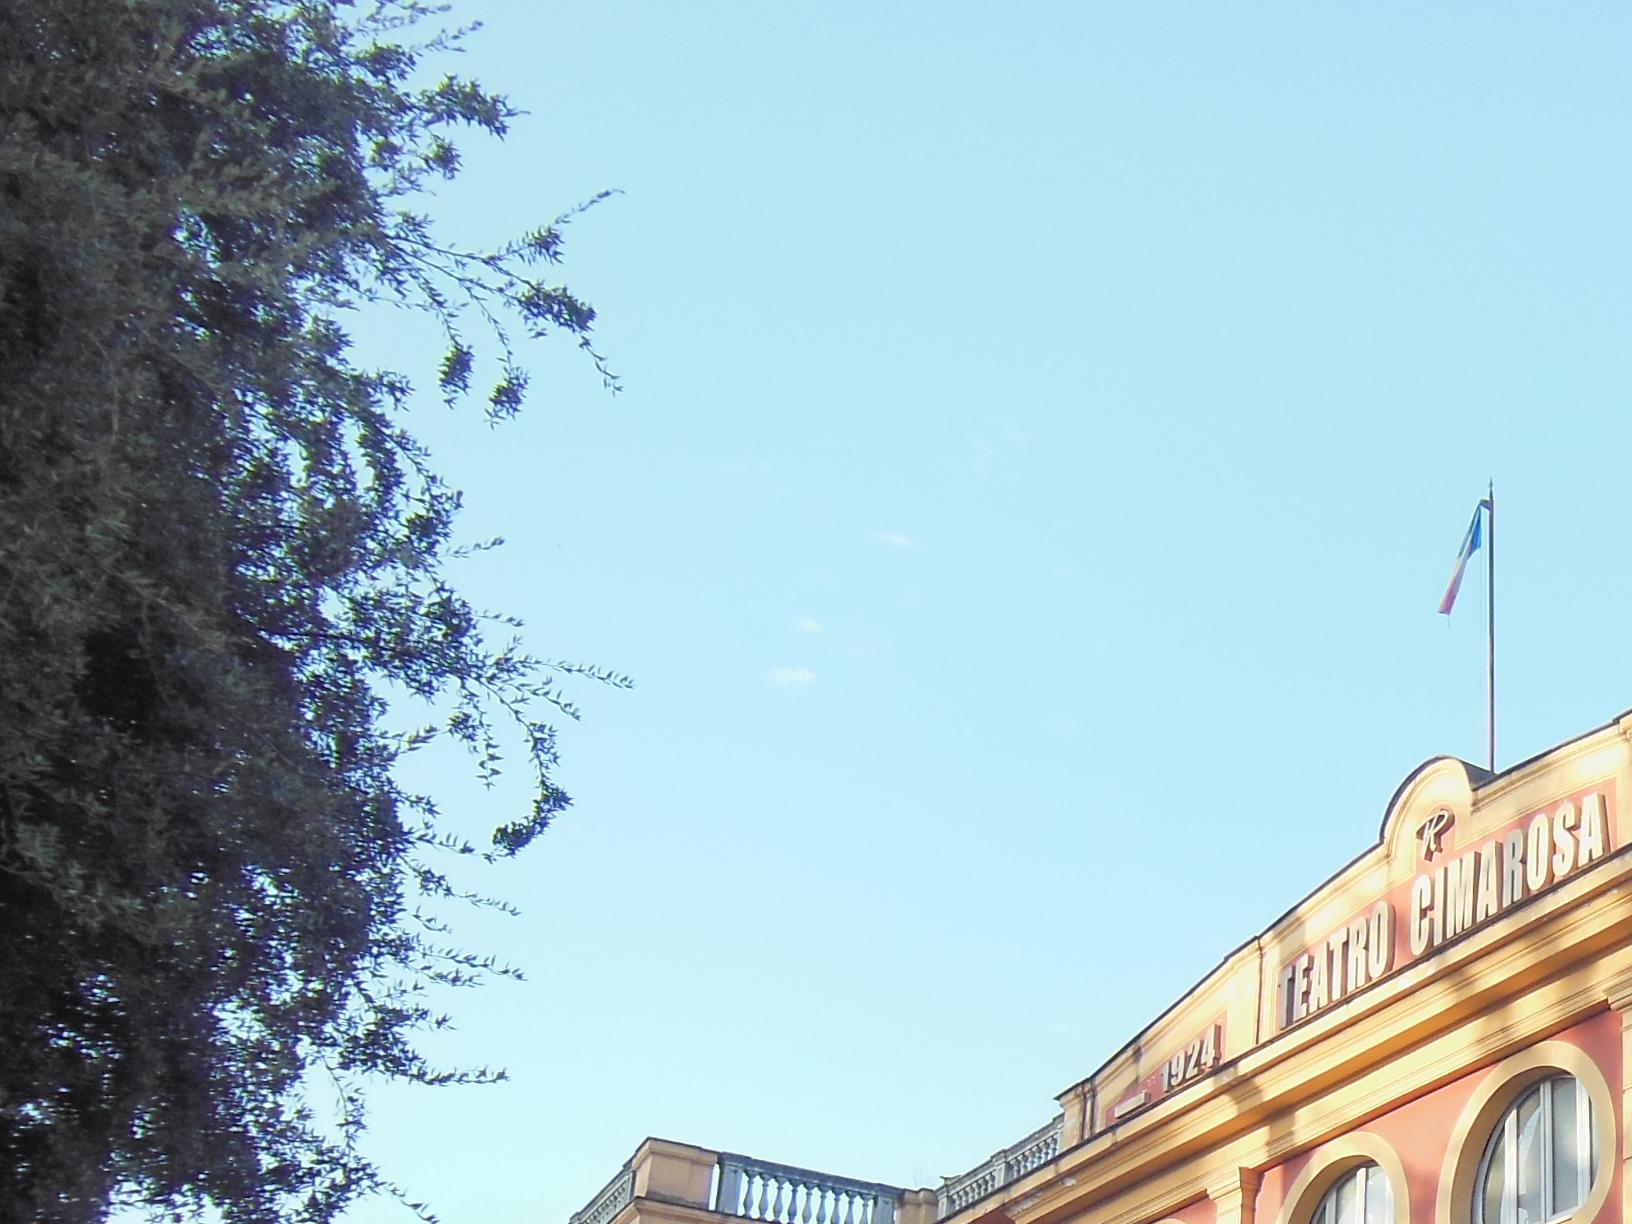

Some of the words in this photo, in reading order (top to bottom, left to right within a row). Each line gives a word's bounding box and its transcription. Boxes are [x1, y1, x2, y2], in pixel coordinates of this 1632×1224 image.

[1279, 900, 1395, 1030] TEATRO
[1410, 792, 1611, 957] CIMAROSA
[1161, 1023, 1221, 1093] 1924
